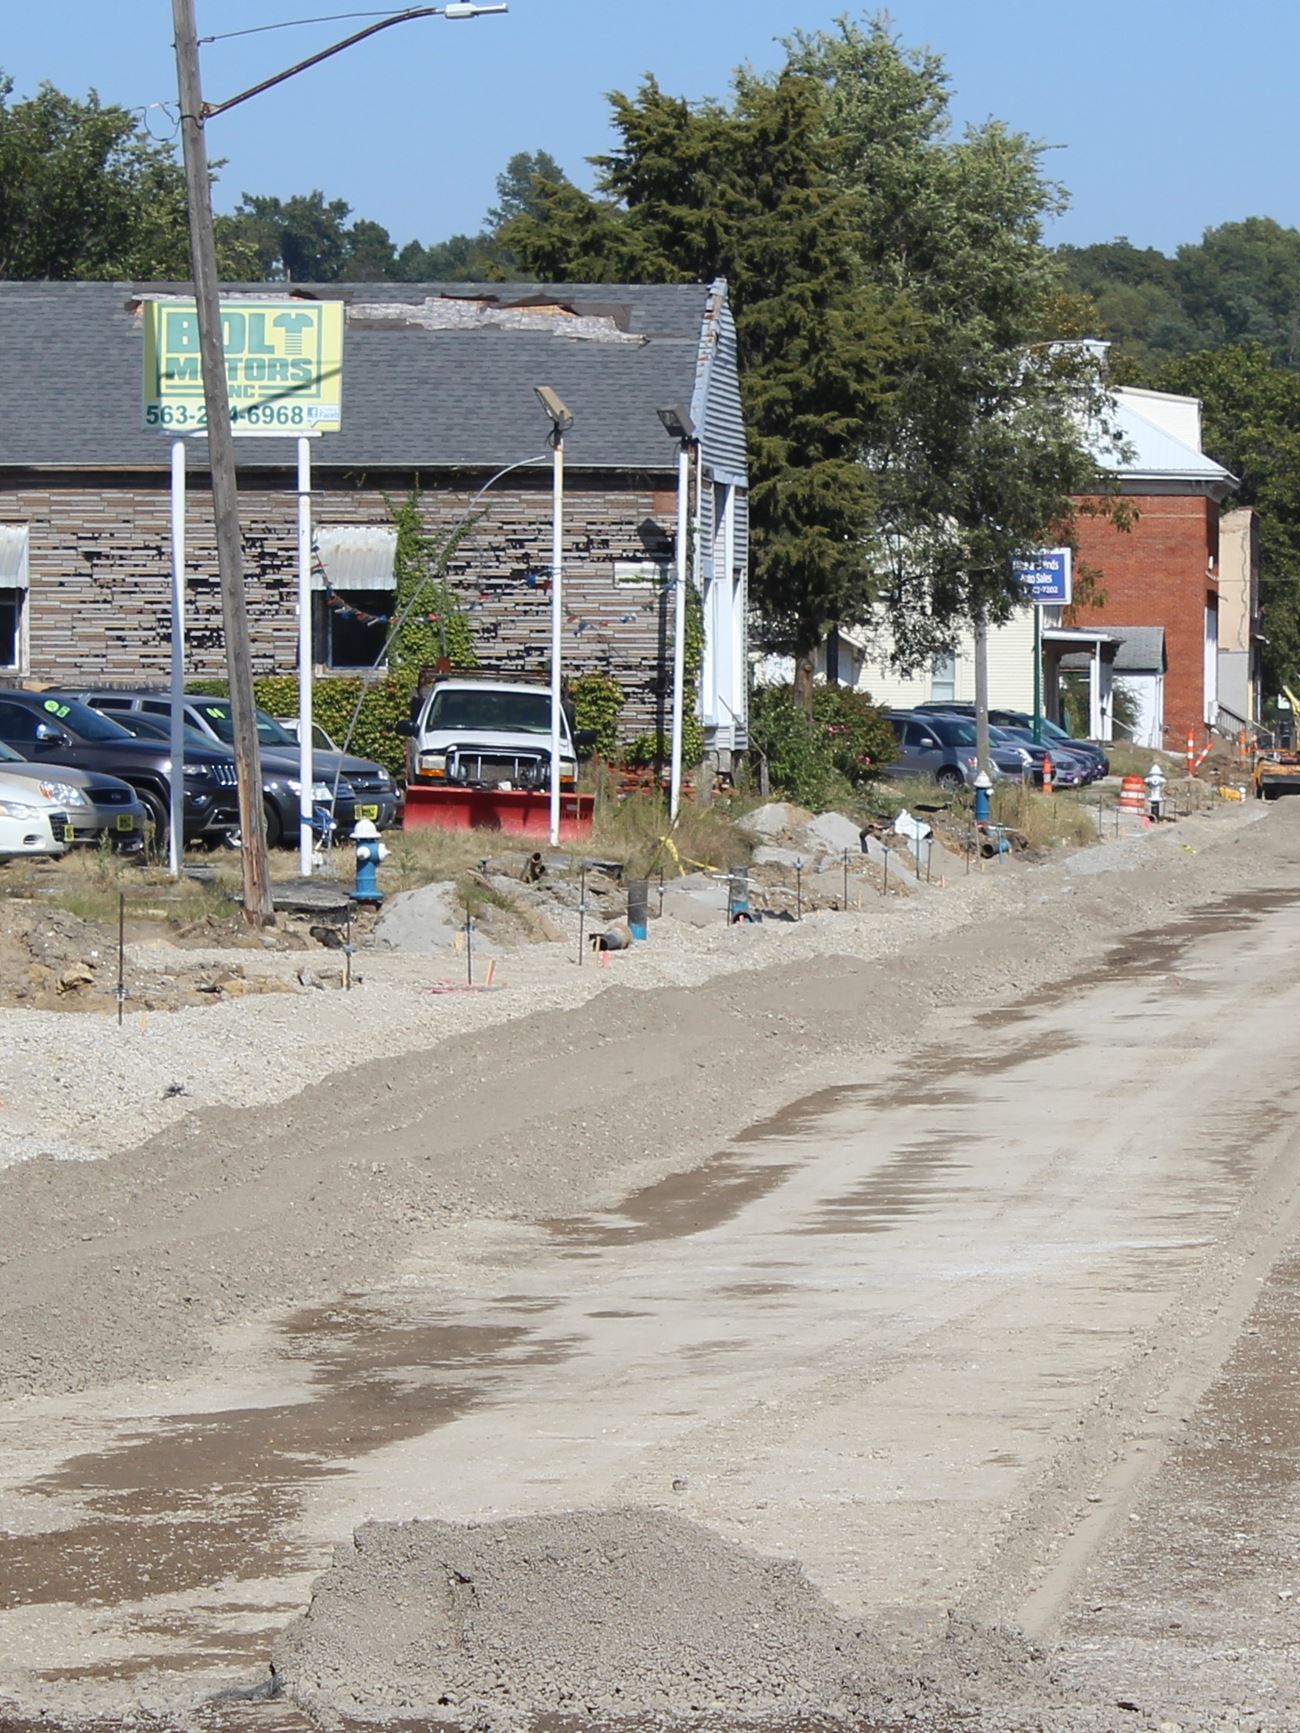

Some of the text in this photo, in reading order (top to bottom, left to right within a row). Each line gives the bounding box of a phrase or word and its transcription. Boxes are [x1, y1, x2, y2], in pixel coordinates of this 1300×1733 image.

[166, 358, 313, 381] MTORS
[222, 385, 255, 398] NC
[146, 405, 303, 425] 563-24-6968
[1036, 573, 1053, 584] Sales
